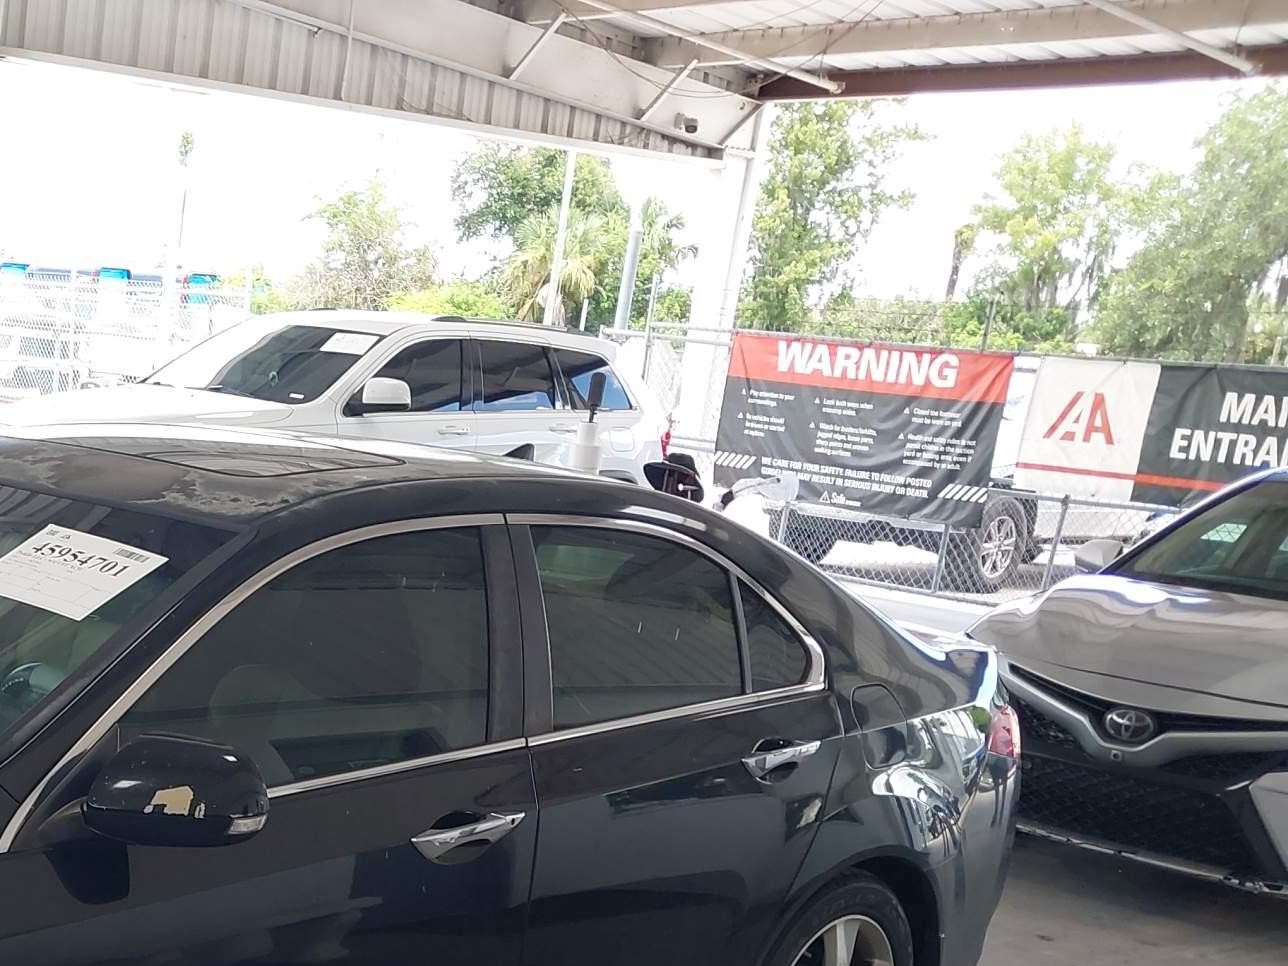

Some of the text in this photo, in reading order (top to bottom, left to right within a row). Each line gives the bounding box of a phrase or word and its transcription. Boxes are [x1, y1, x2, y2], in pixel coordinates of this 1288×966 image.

[776, 340, 960, 389] WARNING
[871, 472, 880, 481] TO
[879, 472, 906, 485] FOLLOW
[906, 476, 932, 488] POSTED
[895, 486, 906, 496] OR
[31, 542, 130, 577] 45954701
